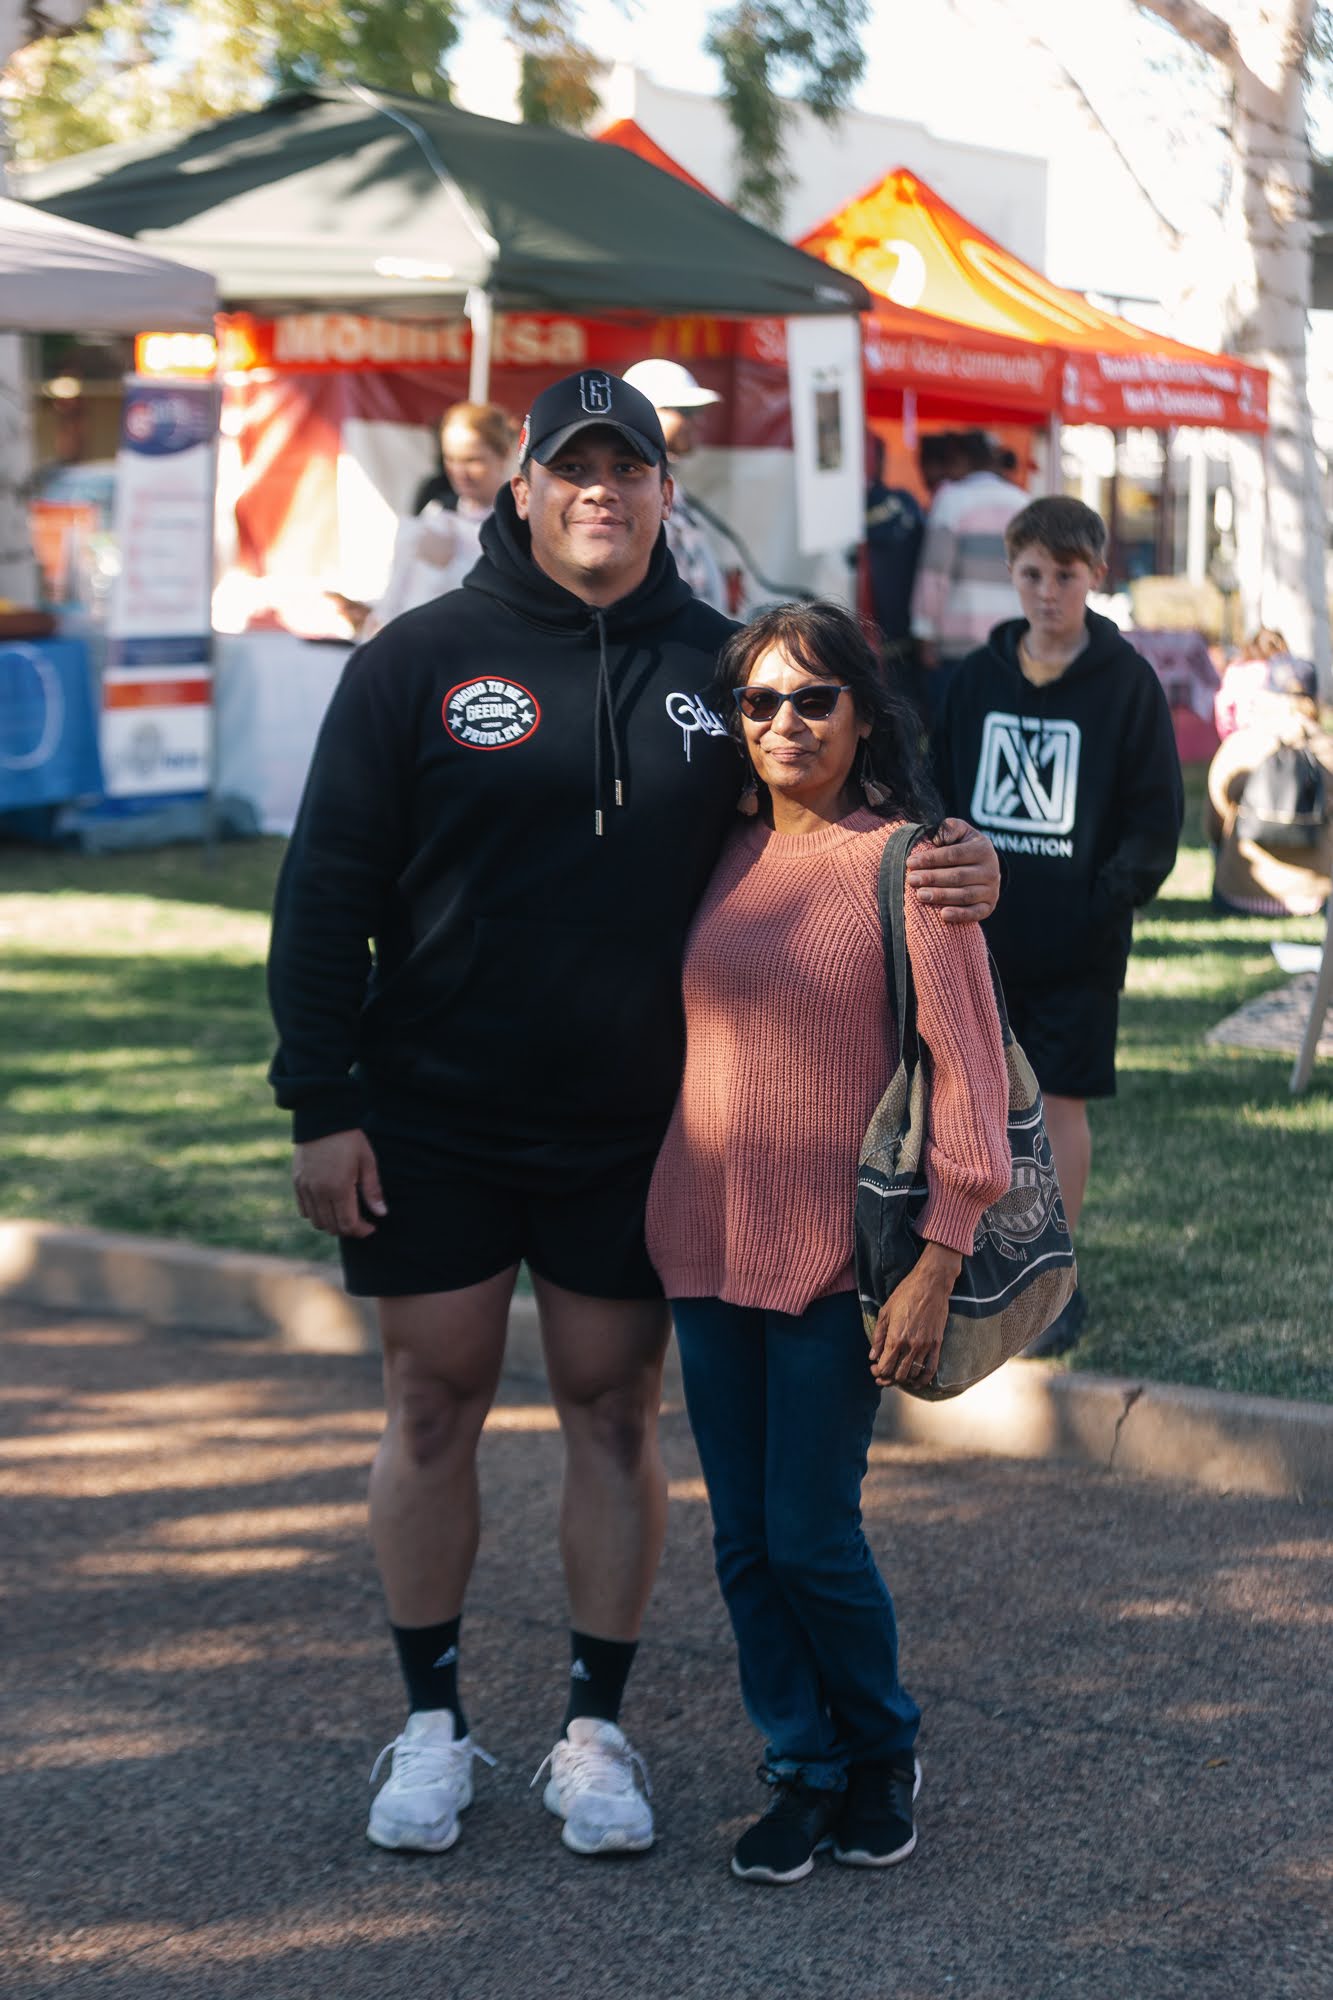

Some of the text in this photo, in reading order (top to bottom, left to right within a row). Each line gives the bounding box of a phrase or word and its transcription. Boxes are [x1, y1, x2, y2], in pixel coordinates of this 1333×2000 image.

[449, 680, 531, 712] PROUD TO BE A
[461, 721, 525, 745] PROBLEM
[983, 830, 1074, 858] WNATION
